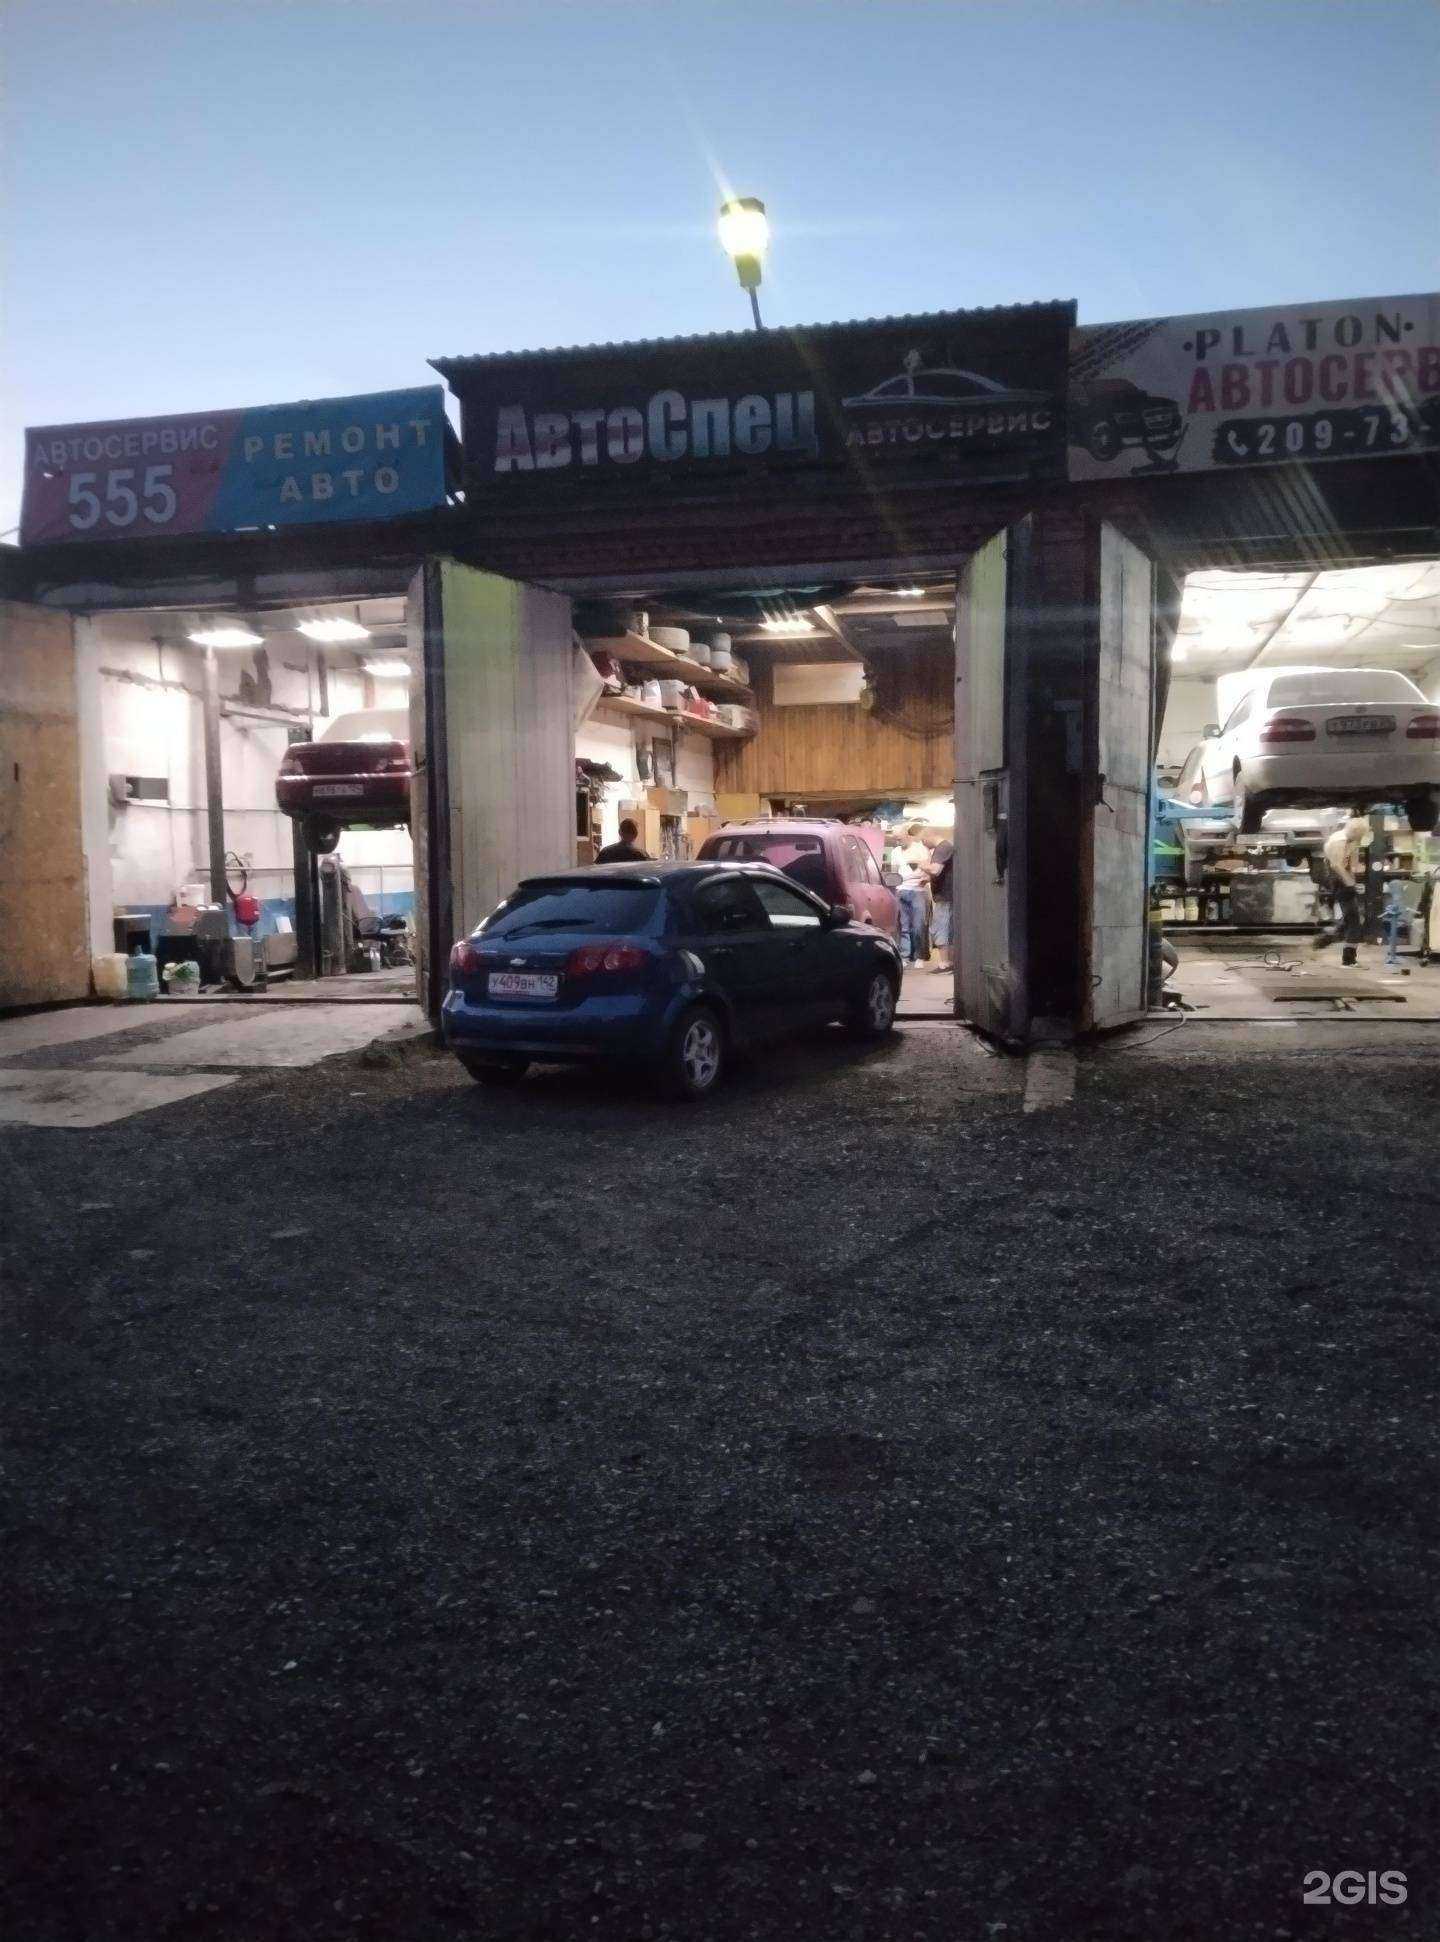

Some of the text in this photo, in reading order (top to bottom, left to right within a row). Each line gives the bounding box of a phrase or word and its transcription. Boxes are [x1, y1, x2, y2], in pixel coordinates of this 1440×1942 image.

[33, 425, 219, 466] АВТОСЕРВИС
[243, 417, 431, 463] РЕМОНТ
[494, 388, 820, 471] АвтоСпец
[845, 410, 1053, 447] АВТОСЕРВИС
[67, 464, 177, 530] 555
[279, 466, 401, 504] АВТО
